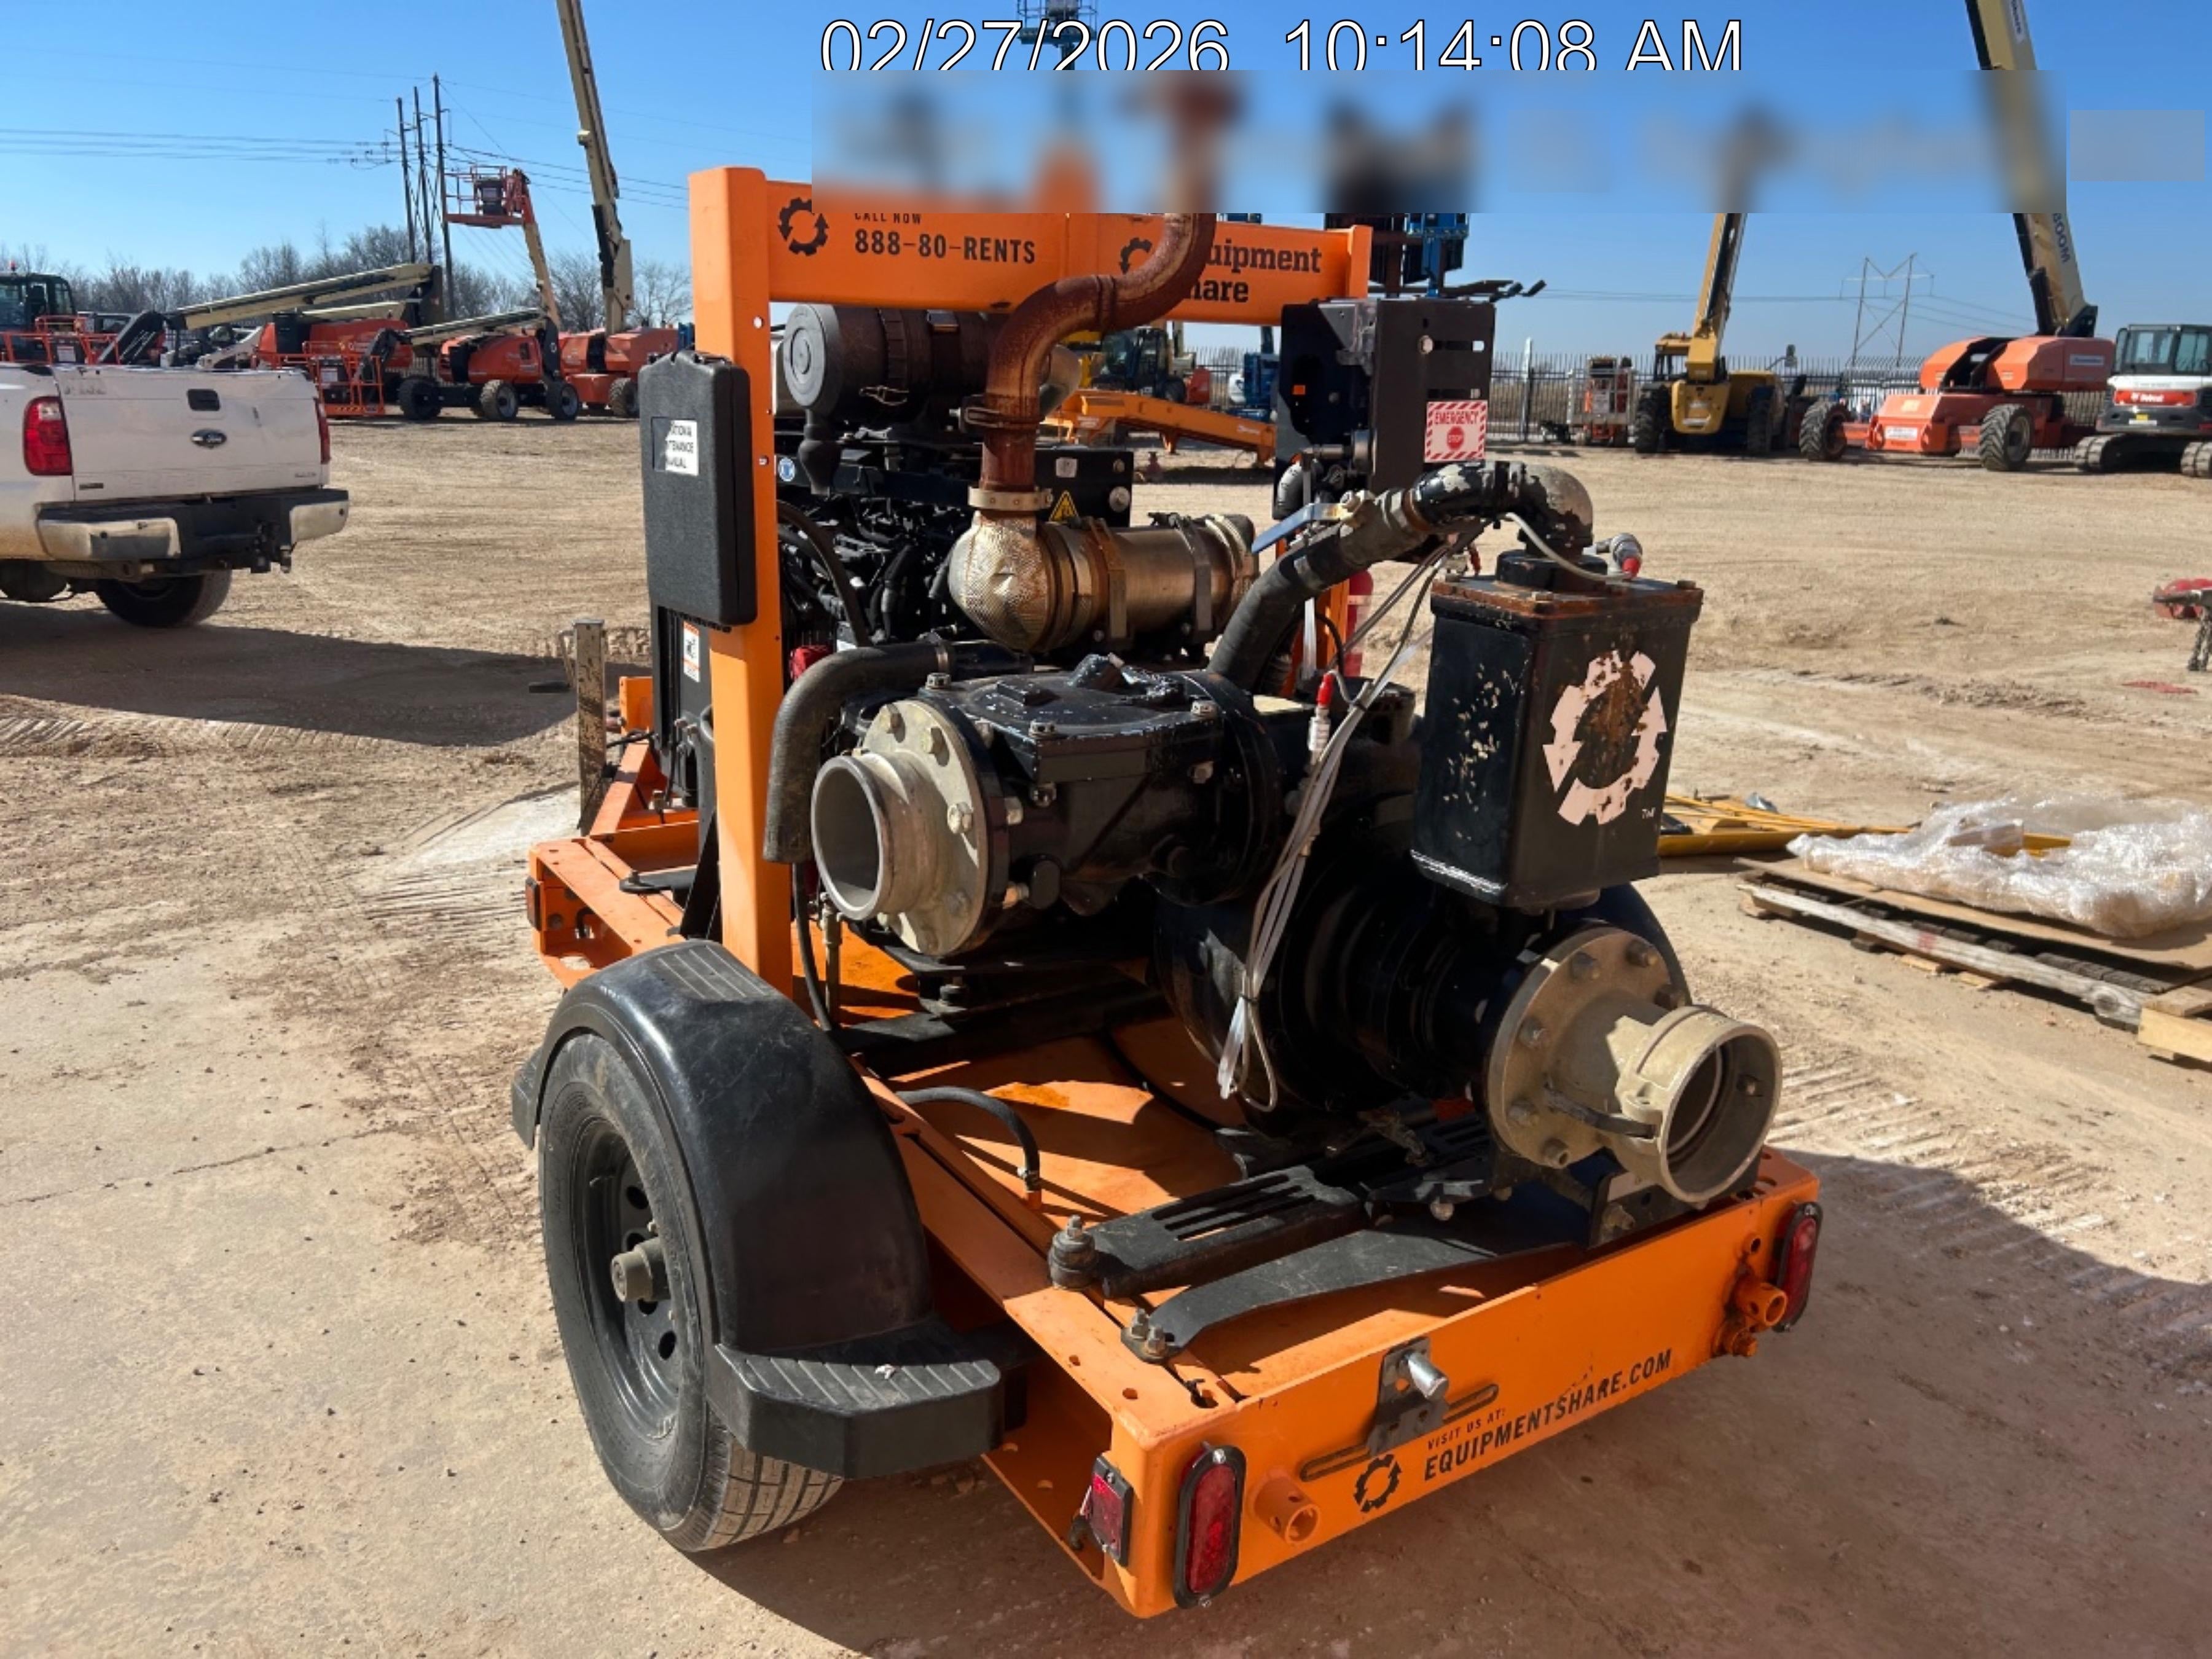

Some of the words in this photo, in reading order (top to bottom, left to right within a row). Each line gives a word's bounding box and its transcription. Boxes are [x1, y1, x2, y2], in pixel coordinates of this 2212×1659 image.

[893, 213, 921, 224] NOW
[855, 229, 1035, 264] 888-80-RENTS
[1206, 238, 1322, 273] uipment
[1190, 280, 1249, 302] are
[1434, 410, 1479, 425] EMERGENCY
[1424, 1349, 1673, 1481] EQUIPMENTSHARE.COM
[1427, 1427, 1461, 1450] VISIT
[1466, 1419, 1481, 1433] US
[1487, 1408, 1506, 1427] AT:
